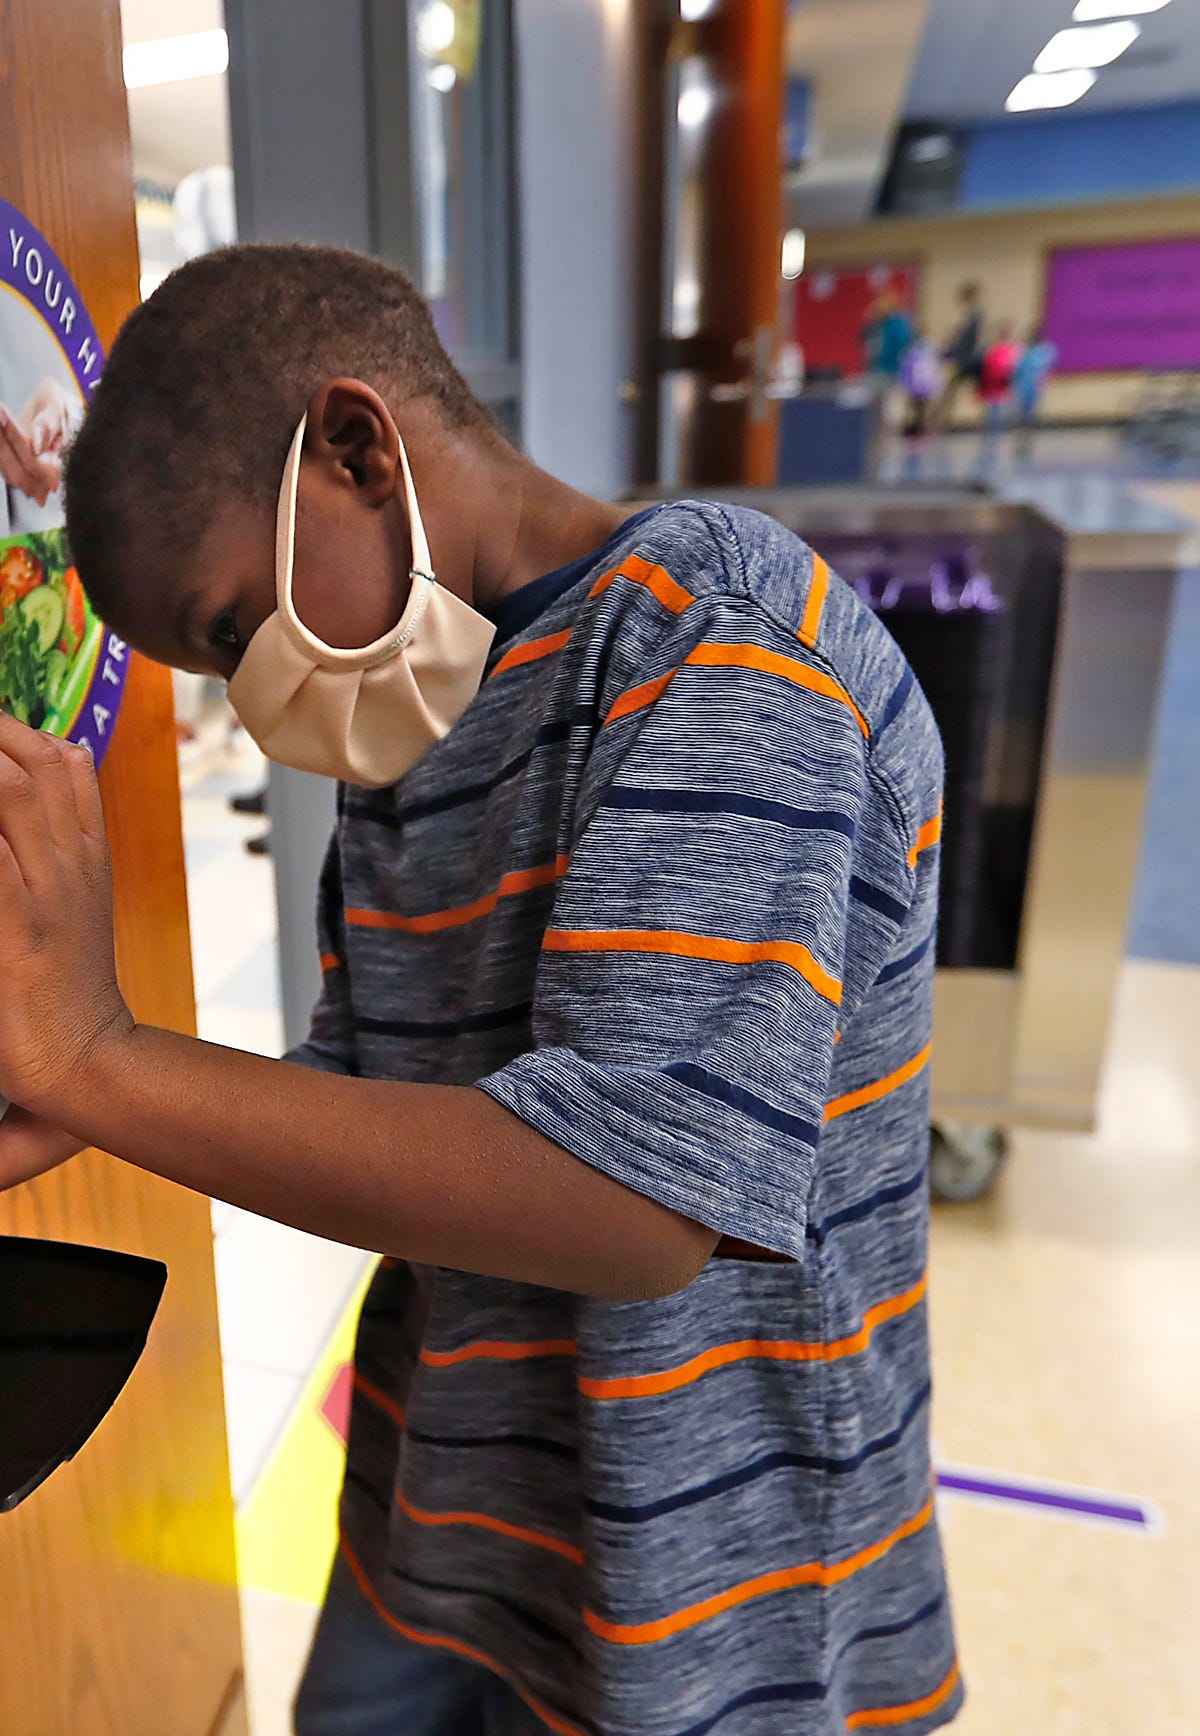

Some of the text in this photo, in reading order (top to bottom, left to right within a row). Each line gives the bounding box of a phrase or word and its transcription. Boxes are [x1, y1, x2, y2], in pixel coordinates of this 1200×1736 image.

[10, 228, 77, 334] YOUR
[77, 337, 102, 389] H
[102, 633, 127, 685] TR
